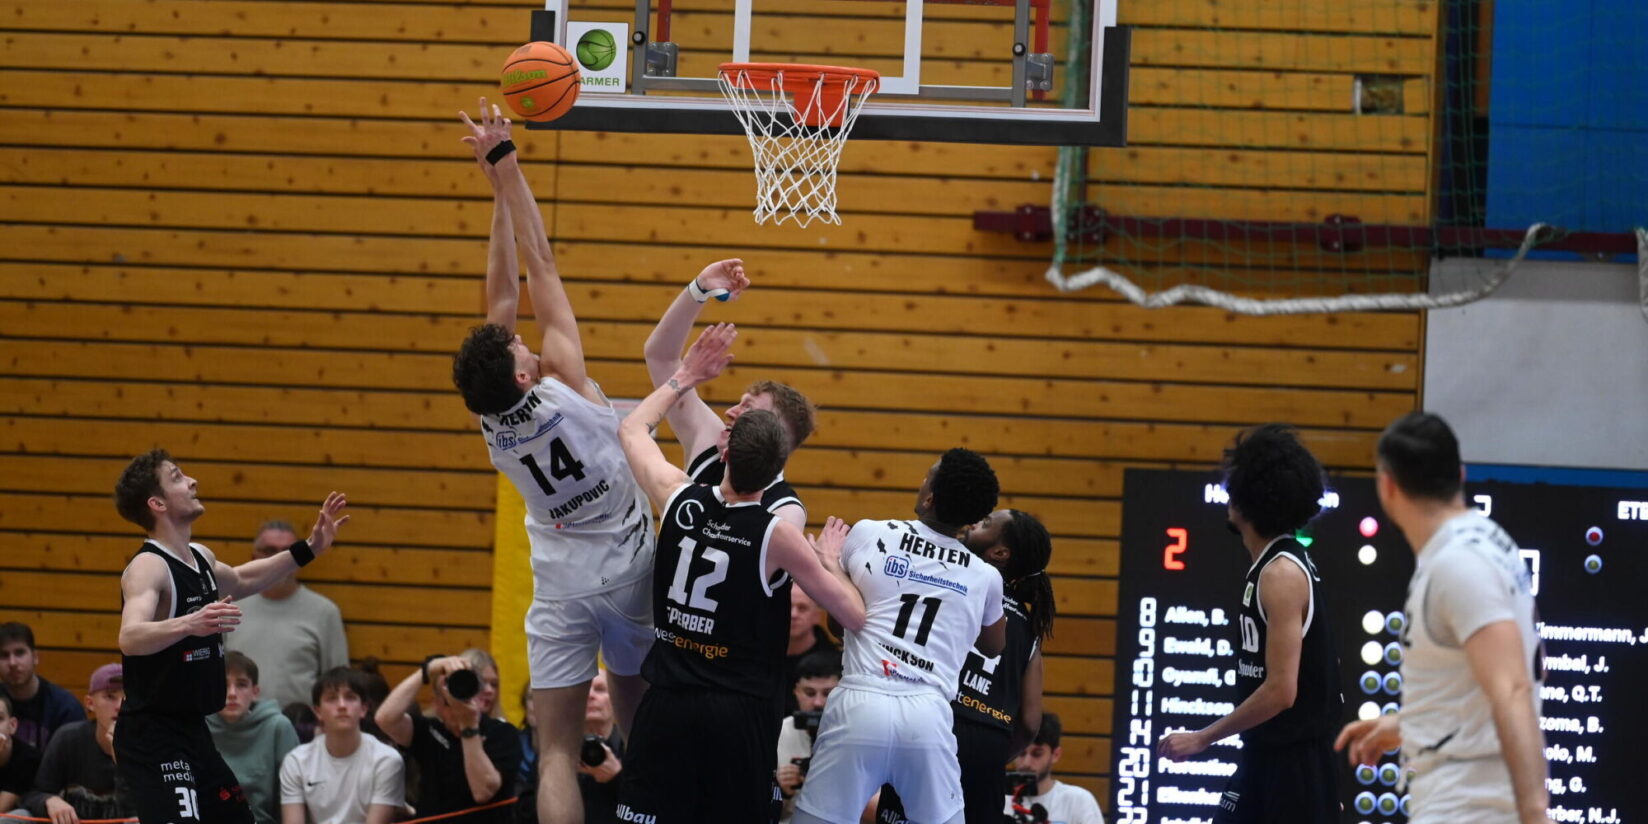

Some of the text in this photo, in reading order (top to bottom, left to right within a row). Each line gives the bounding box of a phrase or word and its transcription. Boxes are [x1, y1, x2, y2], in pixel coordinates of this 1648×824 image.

[579, 77, 620, 87] ARMER
[519, 437, 586, 496] 14
[899, 532, 971, 568] HERTEN
[1163, 528, 1188, 571] 2
[667, 535, 730, 613] 12
[885, 557, 968, 594] ibs Sicherheitstechnik
[667, 605, 715, 636] PERBER
[892, 593, 943, 647] 11
[1140, 597, 1157, 628] 8
[1211, 608, 1229, 626] B.
[1138, 628, 1156, 658] 9
[1593, 656, 1609, 673] J.
[962, 670, 992, 696] LANE
[1571, 685, 1603, 703] Q.T.
[1586, 716, 1604, 733] B.
[160, 759, 191, 772] meta
[1575, 745, 1597, 763] M.
